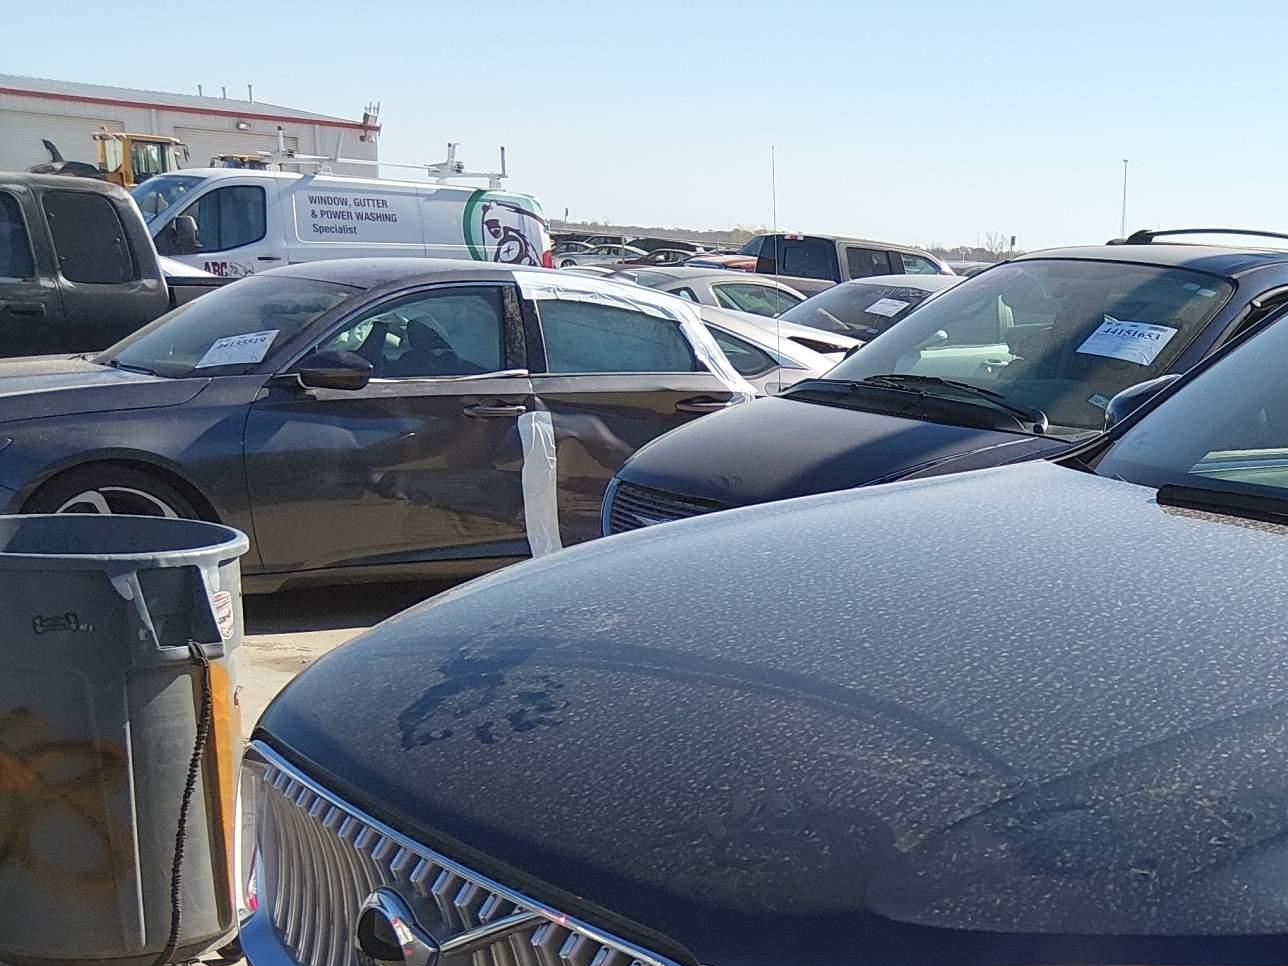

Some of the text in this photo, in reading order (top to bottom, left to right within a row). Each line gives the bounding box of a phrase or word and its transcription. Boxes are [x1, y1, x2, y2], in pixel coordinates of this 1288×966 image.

[308, 195, 389, 209] WINDOW, GUTTER
[310, 209, 398, 223] & POWER WASHING
[312, 223, 358, 235] Specialist
